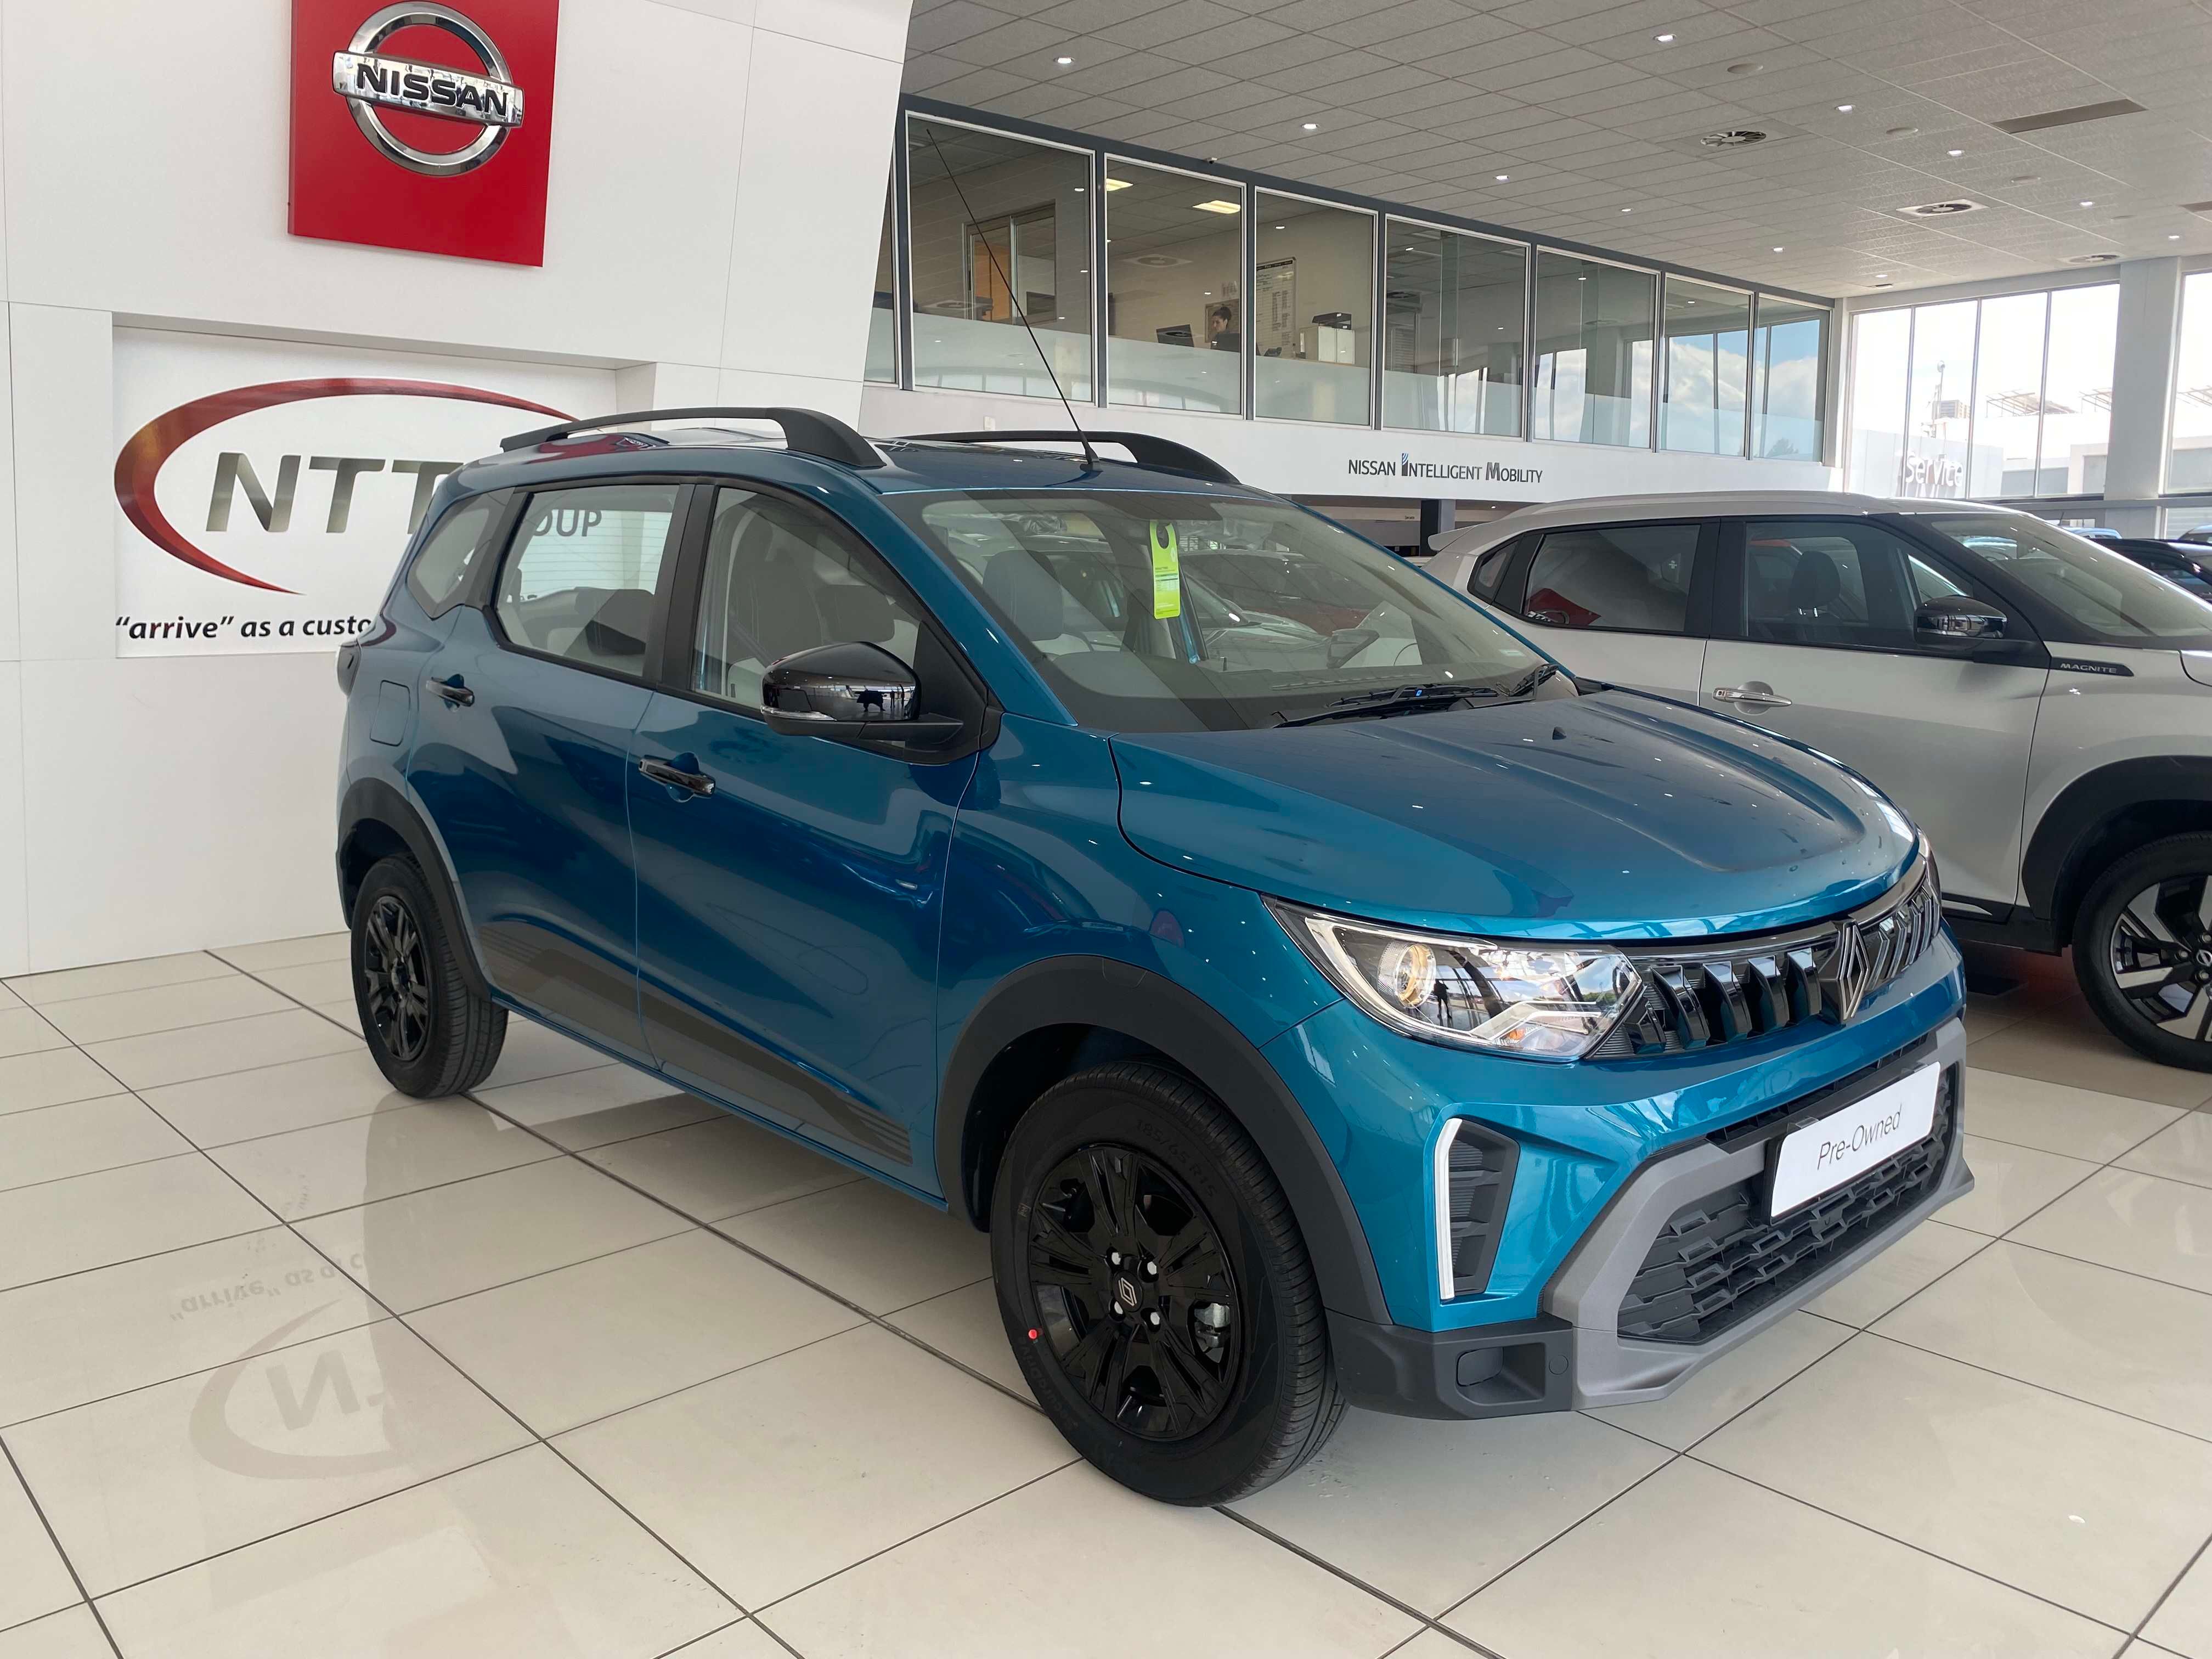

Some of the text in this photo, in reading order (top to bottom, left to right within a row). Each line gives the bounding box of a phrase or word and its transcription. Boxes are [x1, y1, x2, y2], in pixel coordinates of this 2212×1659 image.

[356, 63, 509, 117] NISSAN
[1348, 453, 1543, 483] NISSAN INTELLIGENT MOBILITY
[1905, 452, 1963, 487] Service
[206, 452, 464, 534] NTT
[240, 620, 271, 637] as
[279, 620, 294, 636] a
[2061, 663, 2117, 673] MAGNITE
[1817, 1103, 1902, 1170] Pre-Owned
